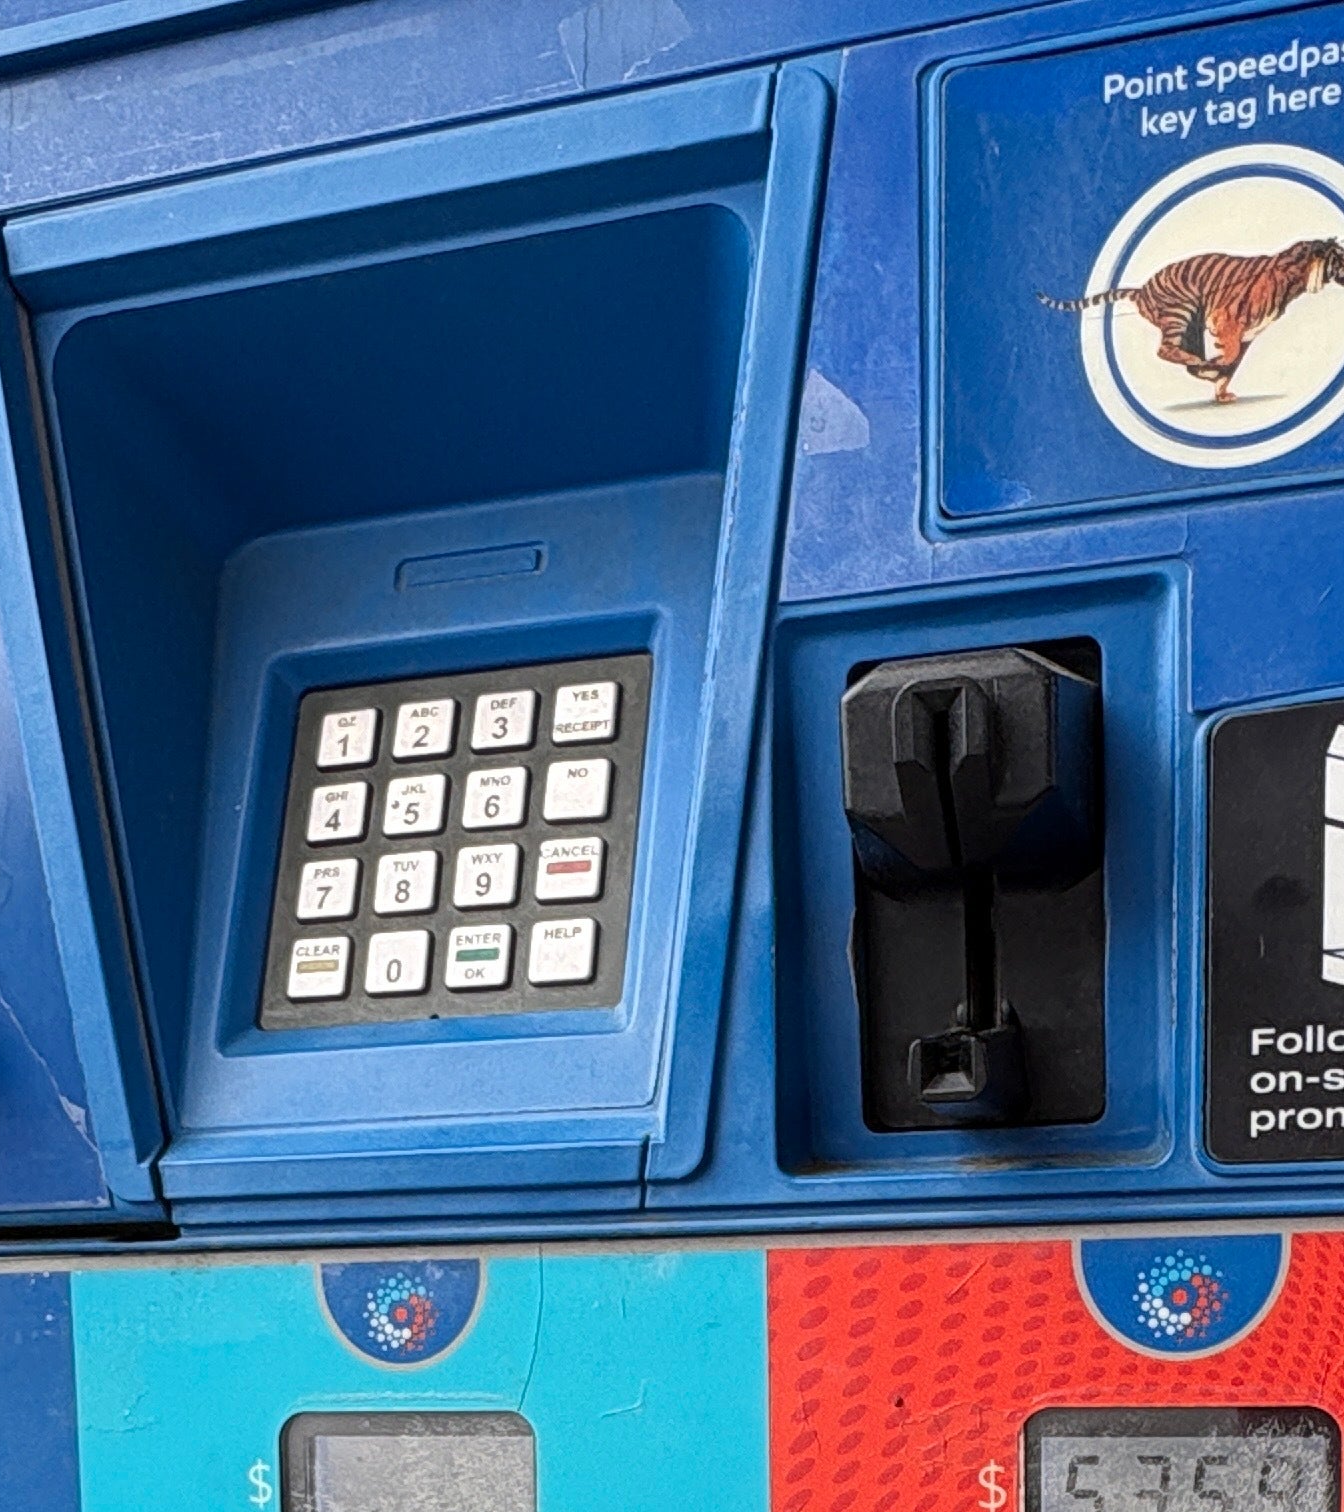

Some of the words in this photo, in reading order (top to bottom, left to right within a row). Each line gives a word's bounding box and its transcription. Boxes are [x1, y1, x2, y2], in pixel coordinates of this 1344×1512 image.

[1104, 65, 1188, 103] Point
[1141, 107, 1197, 139] key
[1205, 96, 1257, 129] tag
[1267, 83, 1342, 115] here
[572, 689, 599, 702] YES
[490, 698, 517, 711] DEF
[410, 706, 439, 718] ABC
[492, 717, 508, 740] 3
[555, 719, 610, 734] RECEIPT
[412, 726, 430, 749] 2
[338, 734, 349, 757] 1
[567, 768, 588, 779] NO
[480, 775, 511, 788] MNO
[401, 783, 426, 796] JKL
[325, 791, 349, 803] GHI
[403, 802, 420, 825] 5
[484, 796, 500, 818] 6
[324, 809, 341, 831] 4
[472, 853, 502, 865] WXY
[540, 845, 599, 859] CANCEL
[394, 861, 419, 872] TUV
[476, 872, 492, 897] 9
[316, 887, 333, 910] 7
[395, 880, 410, 904] 8
[456, 933, 501, 946] ENTER
[544, 927, 582, 940] HELP
[296, 944, 340, 957] CLEAR
[465, 967, 485, 980] OK
[247, 1458, 273, 1509] $
